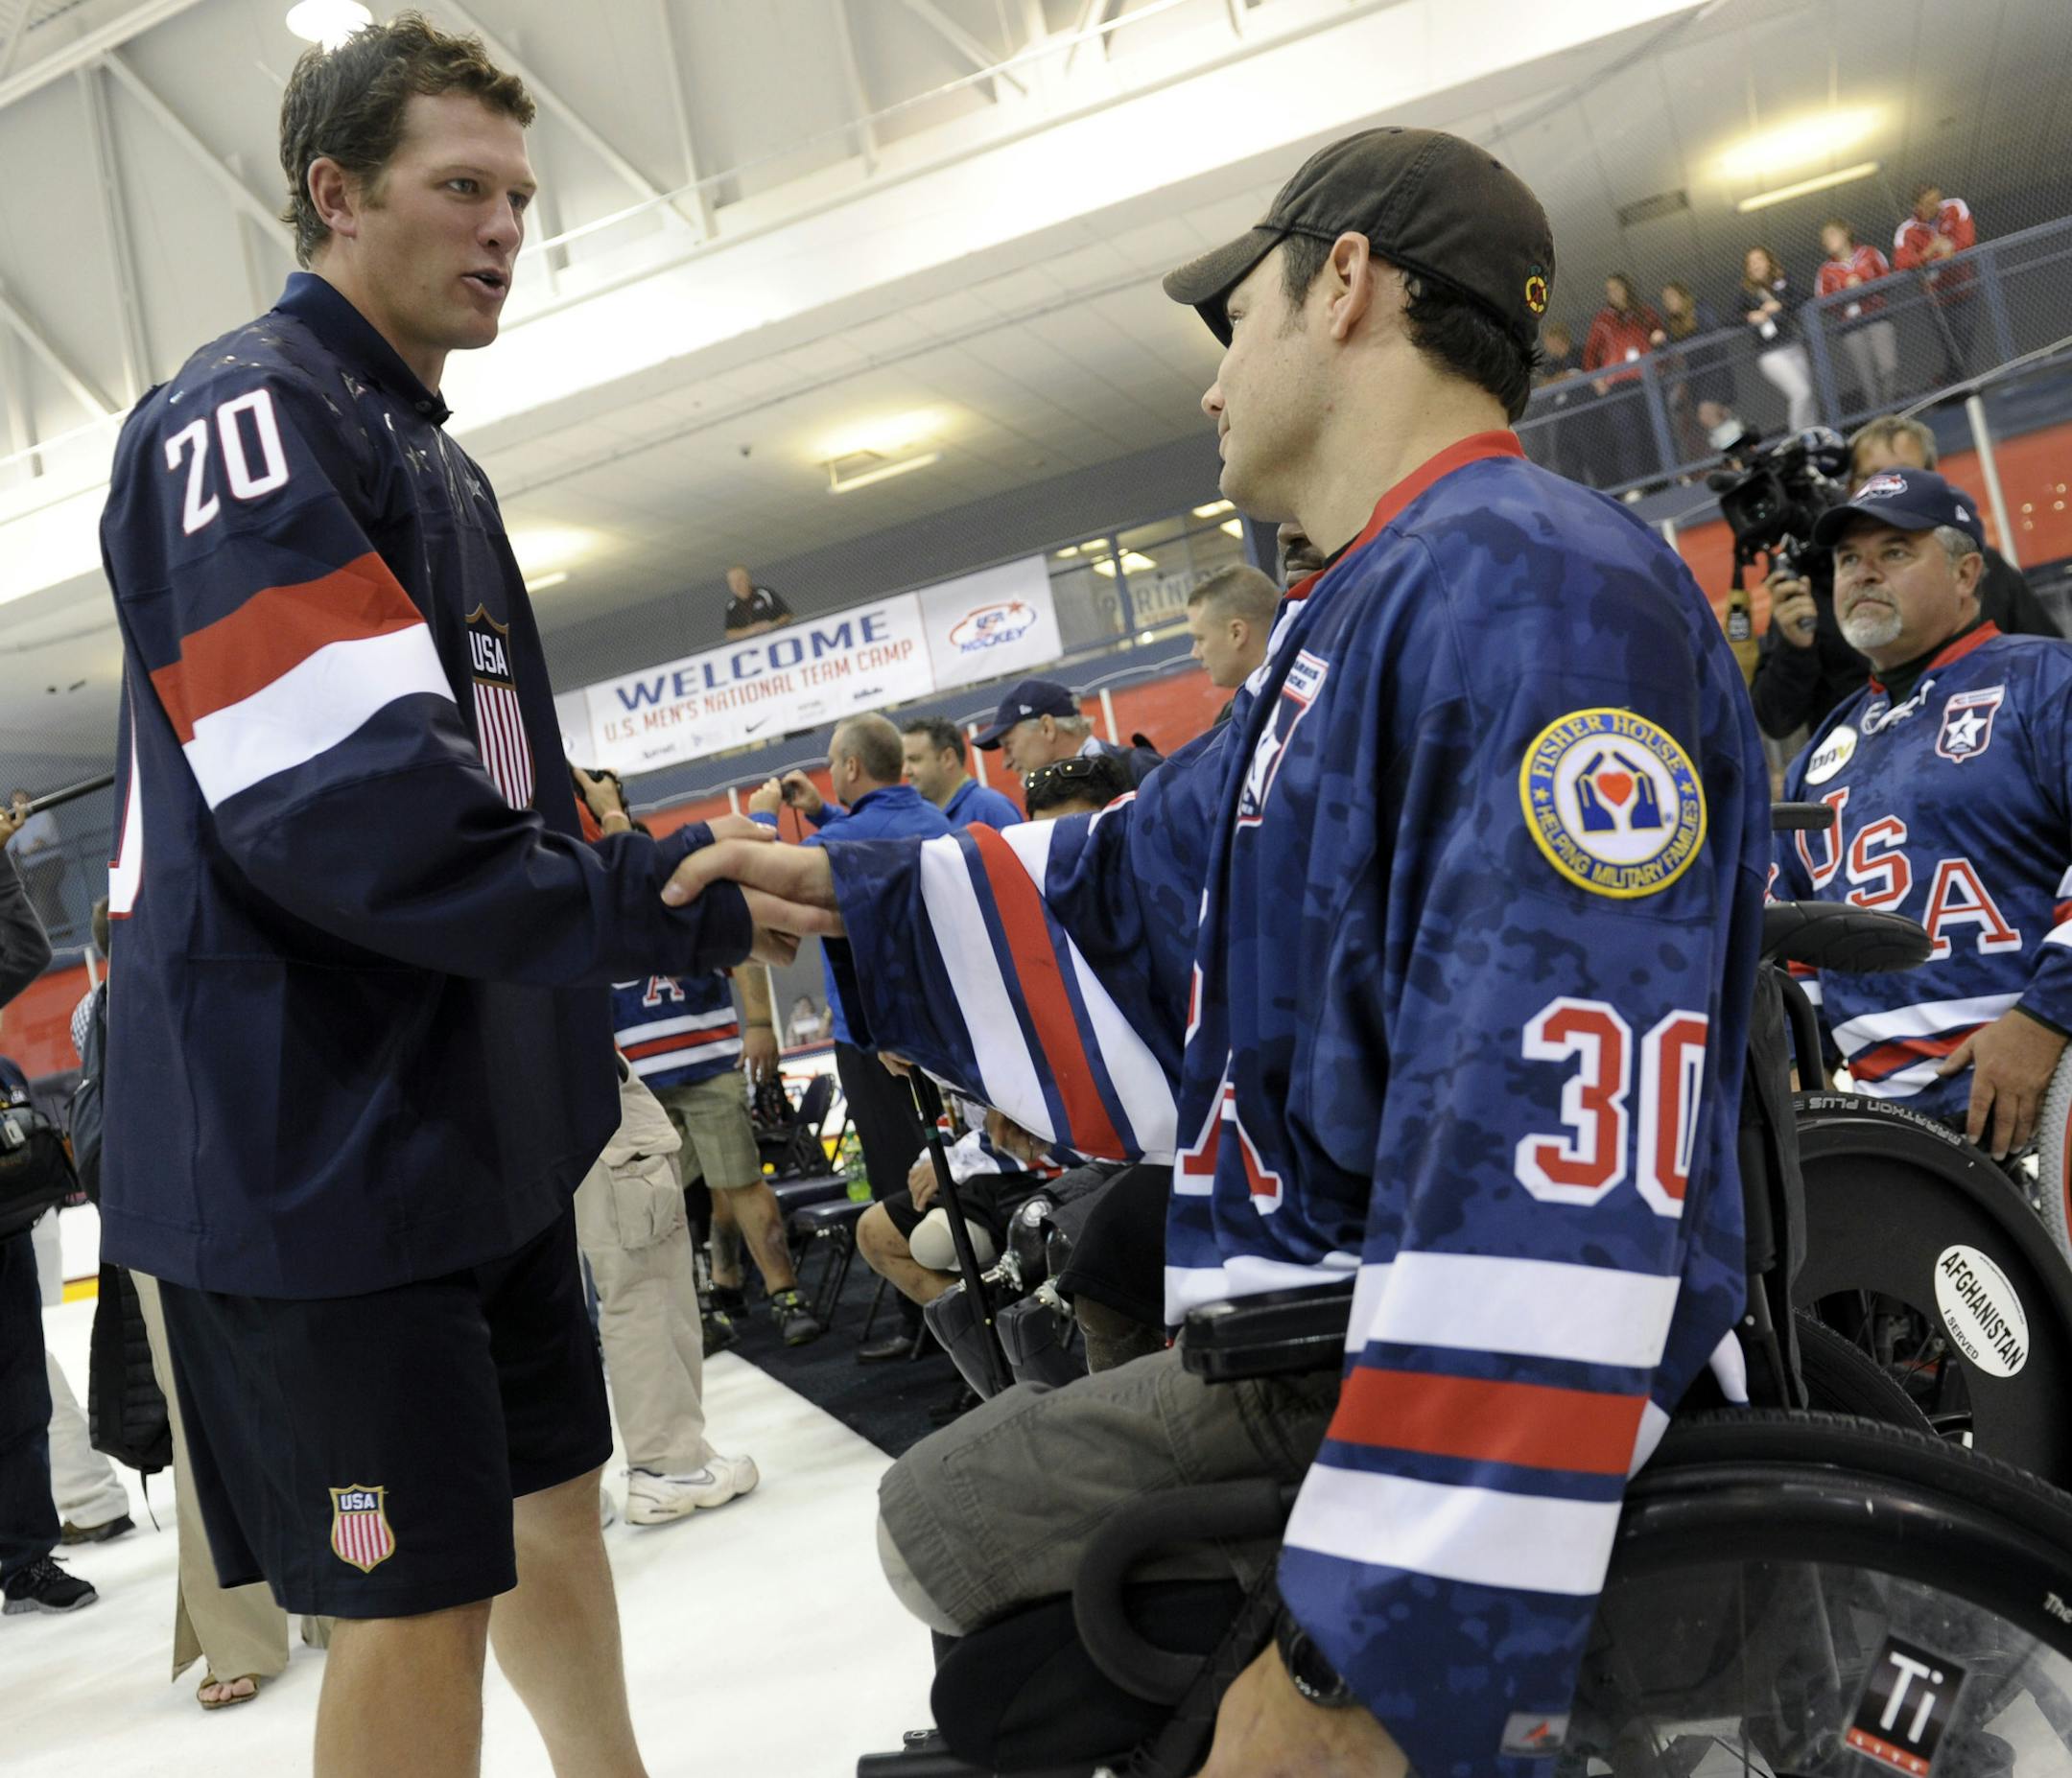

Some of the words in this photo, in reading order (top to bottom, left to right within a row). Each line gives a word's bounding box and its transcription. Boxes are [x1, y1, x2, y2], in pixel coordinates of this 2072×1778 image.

[164, 387, 290, 537] 20
[468, 629, 509, 677] USA
[616, 610, 890, 711] WELCOME
[960, 624, 1028, 653] HOCKEY
[604, 717, 636, 742] U.S.
[644, 699, 699, 731] MEN'S
[703, 673, 795, 714] NATIONAL
[800, 656, 852, 688] TEAM
[857, 639, 913, 671] CAMP
[1532, 714, 1606, 778] FISHER
[1612, 714, 1685, 774] HOUSE
[1535, 803, 1593, 875] HELPING
[1590, 856, 1666, 888] MILITARY
[1663, 798, 1700, 870] FAMILIES
[1795, 785, 2023, 962] USA
[1513, 995, 1709, 1219] 30
[1809, 1096, 1860, 1111] PLUS
[1867, 1100, 1963, 1147] MARATHON
[1940, 1252, 2025, 1371] AFGHANISTAN
[1947, 1316, 1980, 1361] SERVED
[340, 1492, 376, 1510] USA
[1879, 1650, 1944, 1744] Ti
